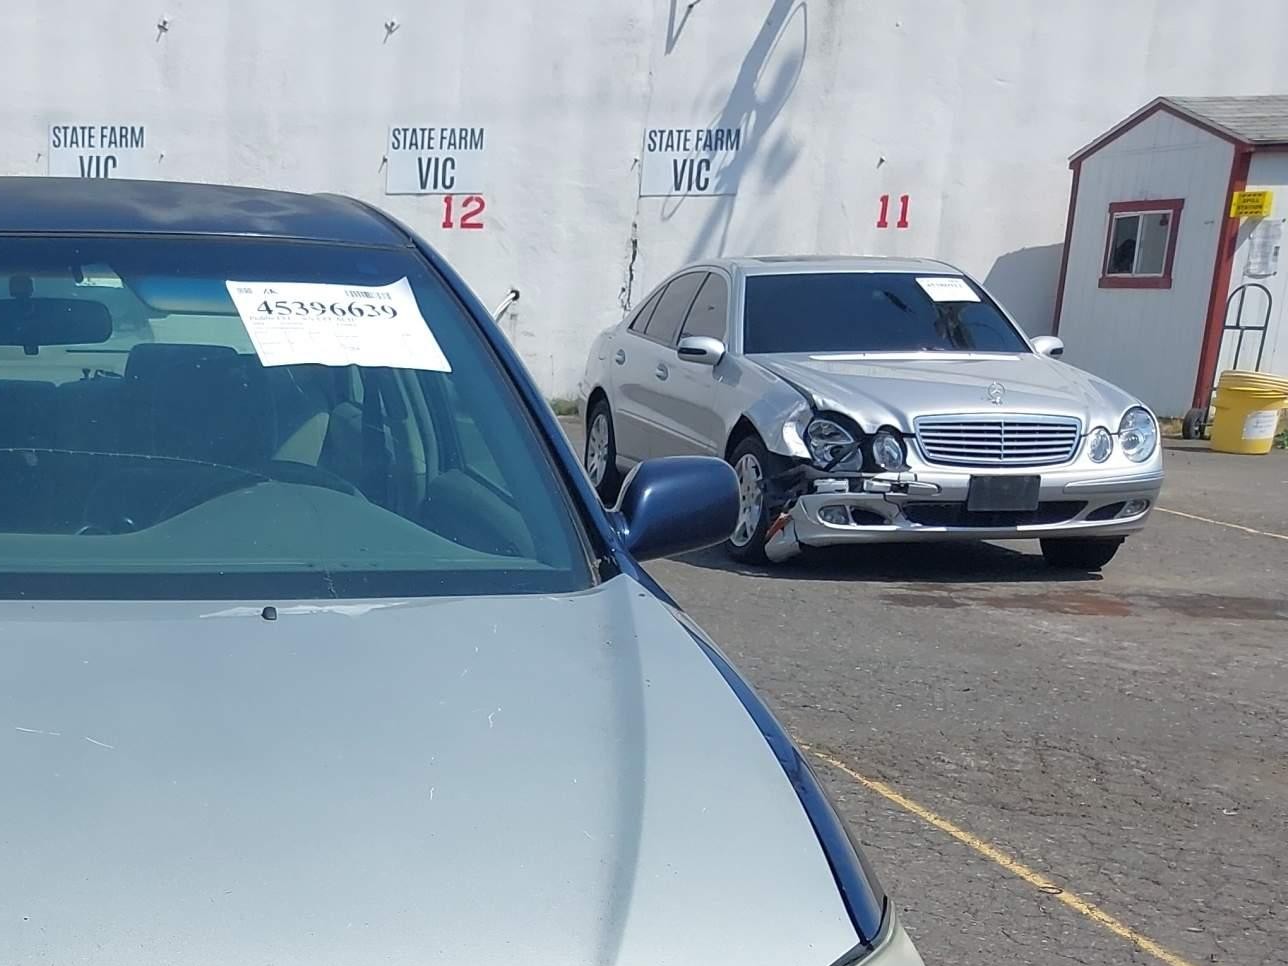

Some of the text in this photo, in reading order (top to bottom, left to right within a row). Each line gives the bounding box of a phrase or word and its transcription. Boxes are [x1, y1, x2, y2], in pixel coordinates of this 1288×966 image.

[52, 125, 145, 149] STATE FARM
[391, 127, 485, 151] STATE FARM
[647, 128, 741, 153] STATE FARM
[417, 156, 456, 190] VIC
[672, 158, 711, 192] VIC
[442, 195, 486, 229] 12
[876, 194, 910, 229] 11
[256, 299, 398, 320] 45396639
